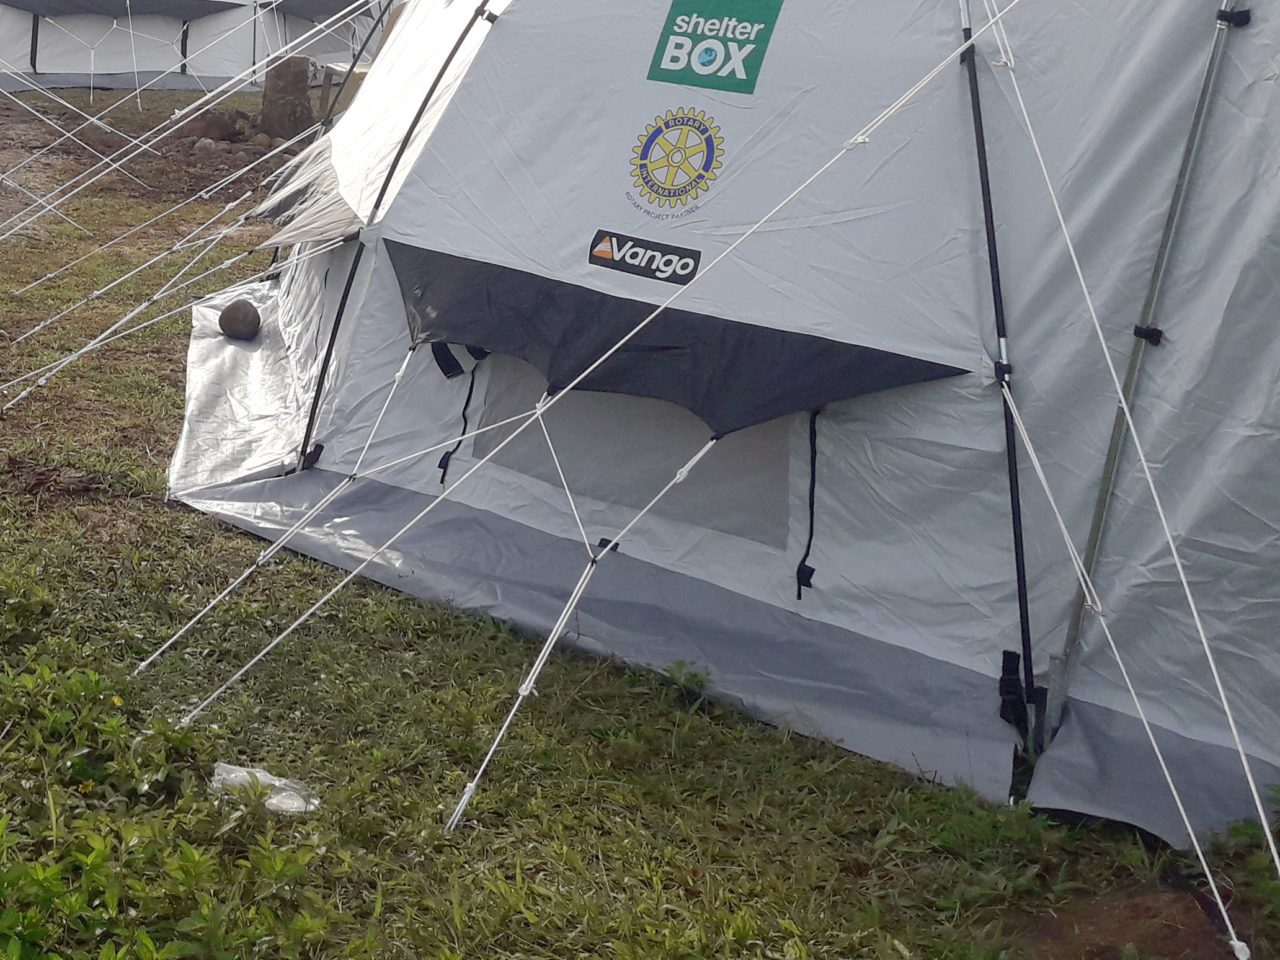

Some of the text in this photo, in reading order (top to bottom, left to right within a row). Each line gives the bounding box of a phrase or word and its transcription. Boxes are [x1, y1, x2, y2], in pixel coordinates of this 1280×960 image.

[673, 13, 765, 41] shelter
[660, 35, 756, 79] BOX
[668, 117, 706, 132] ROTARY
[640, 167, 703, 197] INTERNATIONAL
[611, 237, 695, 278] Vango
